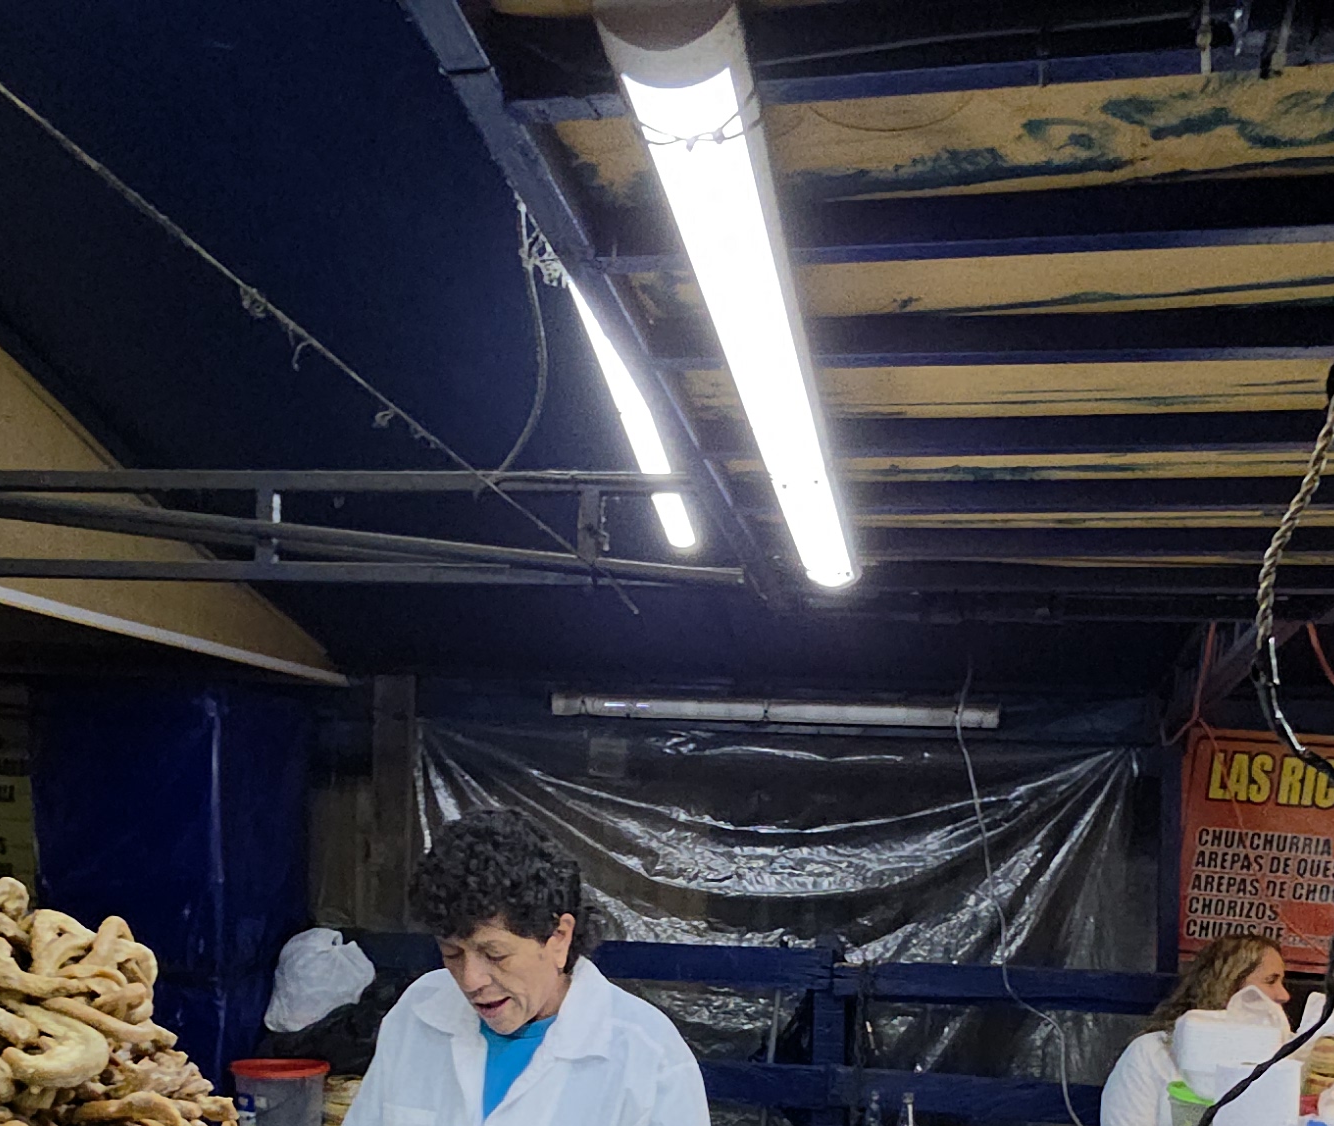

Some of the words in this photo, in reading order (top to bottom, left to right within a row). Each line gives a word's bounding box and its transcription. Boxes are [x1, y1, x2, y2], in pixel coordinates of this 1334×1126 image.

[1208, 751, 1274, 803] LAS
[1198, 828, 1332, 856] CHUNCHURRIA
[1195, 850, 1264, 874] AREPAS
[1269, 854, 1290, 876] DE
[1190, 874, 1259, 898] AREPAS
[1265, 879, 1286, 899] DE
[1188, 897, 1279, 921] CHORIZOS
